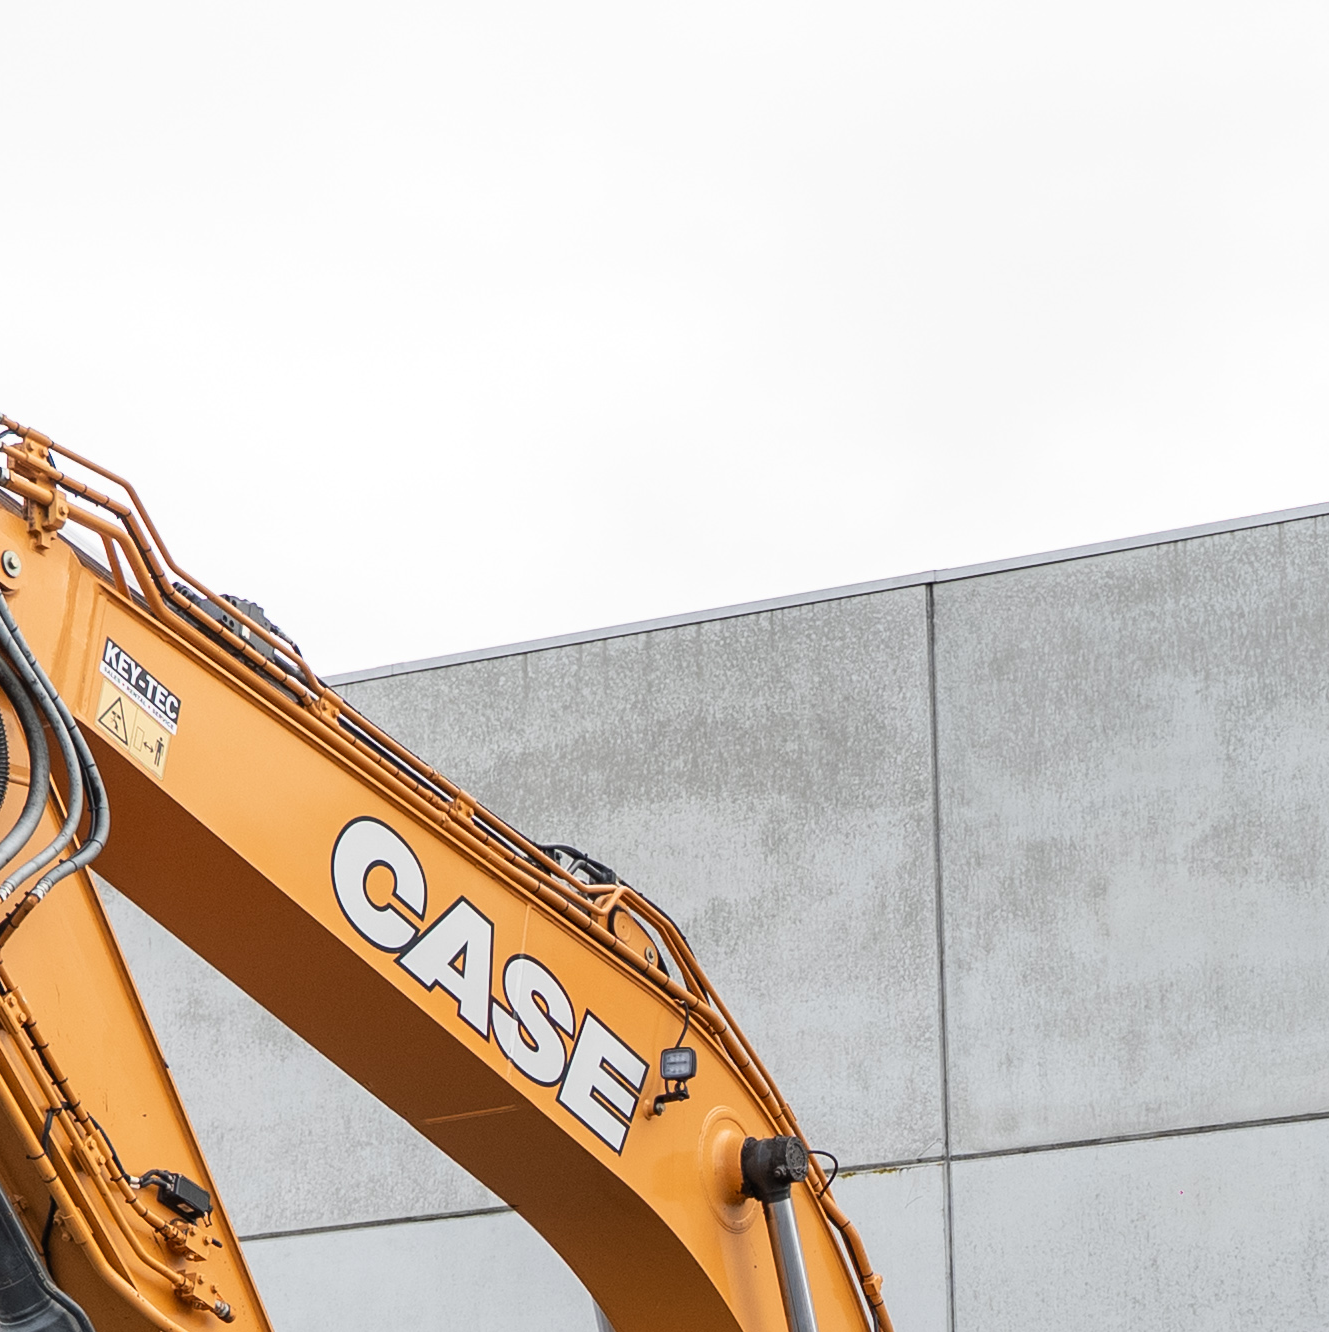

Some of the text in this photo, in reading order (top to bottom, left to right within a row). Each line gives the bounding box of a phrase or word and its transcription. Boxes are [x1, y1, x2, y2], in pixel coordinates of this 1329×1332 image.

[104, 640, 179, 719] KEY-TEC
[104, 666, 174, 730] SALES RENTAL SERVICE
[331, 815, 650, 1157] CASE
